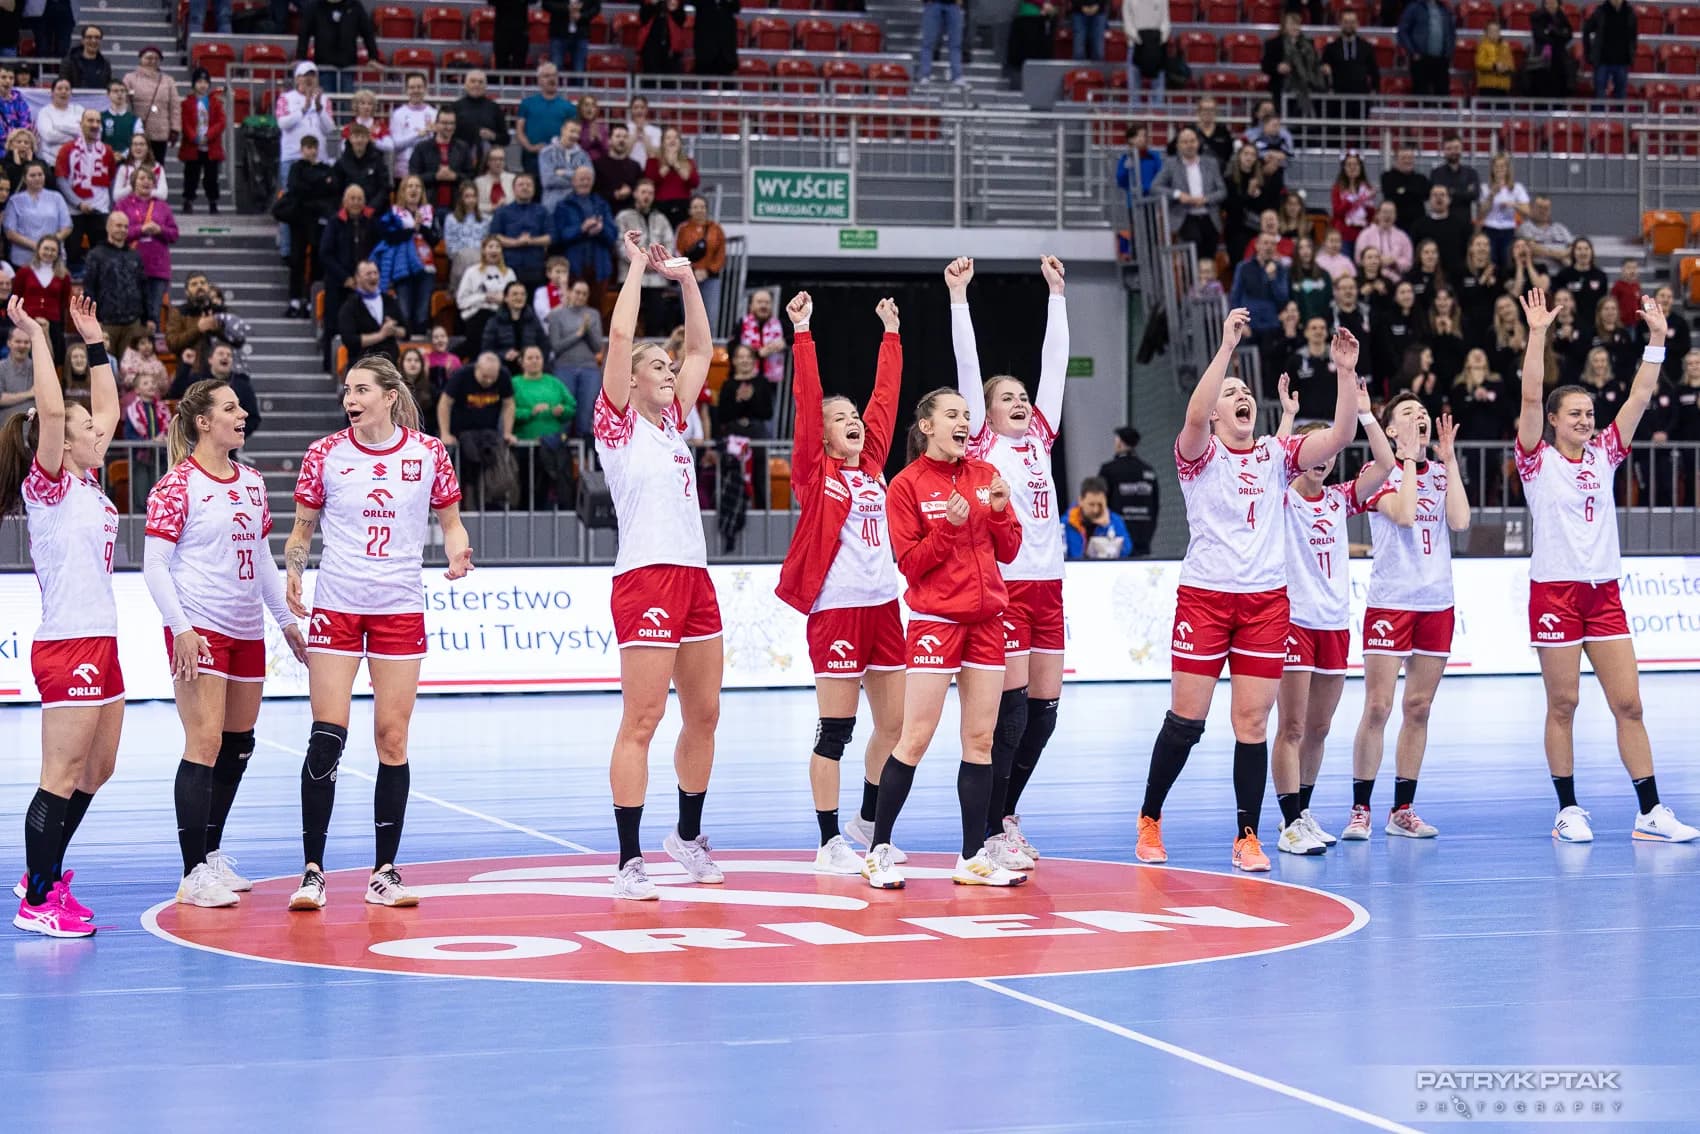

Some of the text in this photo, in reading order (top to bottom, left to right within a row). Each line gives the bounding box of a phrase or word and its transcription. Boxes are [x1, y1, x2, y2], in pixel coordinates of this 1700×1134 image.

[757, 175, 846, 199] WYJŚCIE
[682, 468, 691, 497] 2
[1238, 487, 1264, 495] ORLEN
[362, 510, 396, 519] ORLEN
[858, 504, 882, 512] ORLEN
[1031, 491, 1049, 519] 39
[1246, 501, 1256, 530] 4
[1585, 496, 1595, 522] 6
[231, 533, 256, 542] ORLEN
[366, 525, 391, 557] 22
[862, 518, 881, 548] 40
[1309, 537, 1336, 546] ORLEN
[1422, 528, 1432, 555] 9
[237, 549, 255, 580] 23
[1317, 551, 1331, 580] 11
[424, 585, 571, 611] isterstwo
[638, 628, 672, 639] ORLEN
[1632, 609, 1700, 637] portu
[426, 624, 613, 655] rtu i Turysty
[1368, 638, 1395, 648] ORLEN
[1536, 631, 1565, 640] ORLEN
[197, 655, 214, 666] LEN
[827, 660, 857, 669] ORLEN
[913, 655, 944, 665] ORLEN
[1284, 654, 1301, 663] LEN
[68, 686, 102, 697] ORLEN
[368, 905, 1291, 960] ORLEN
